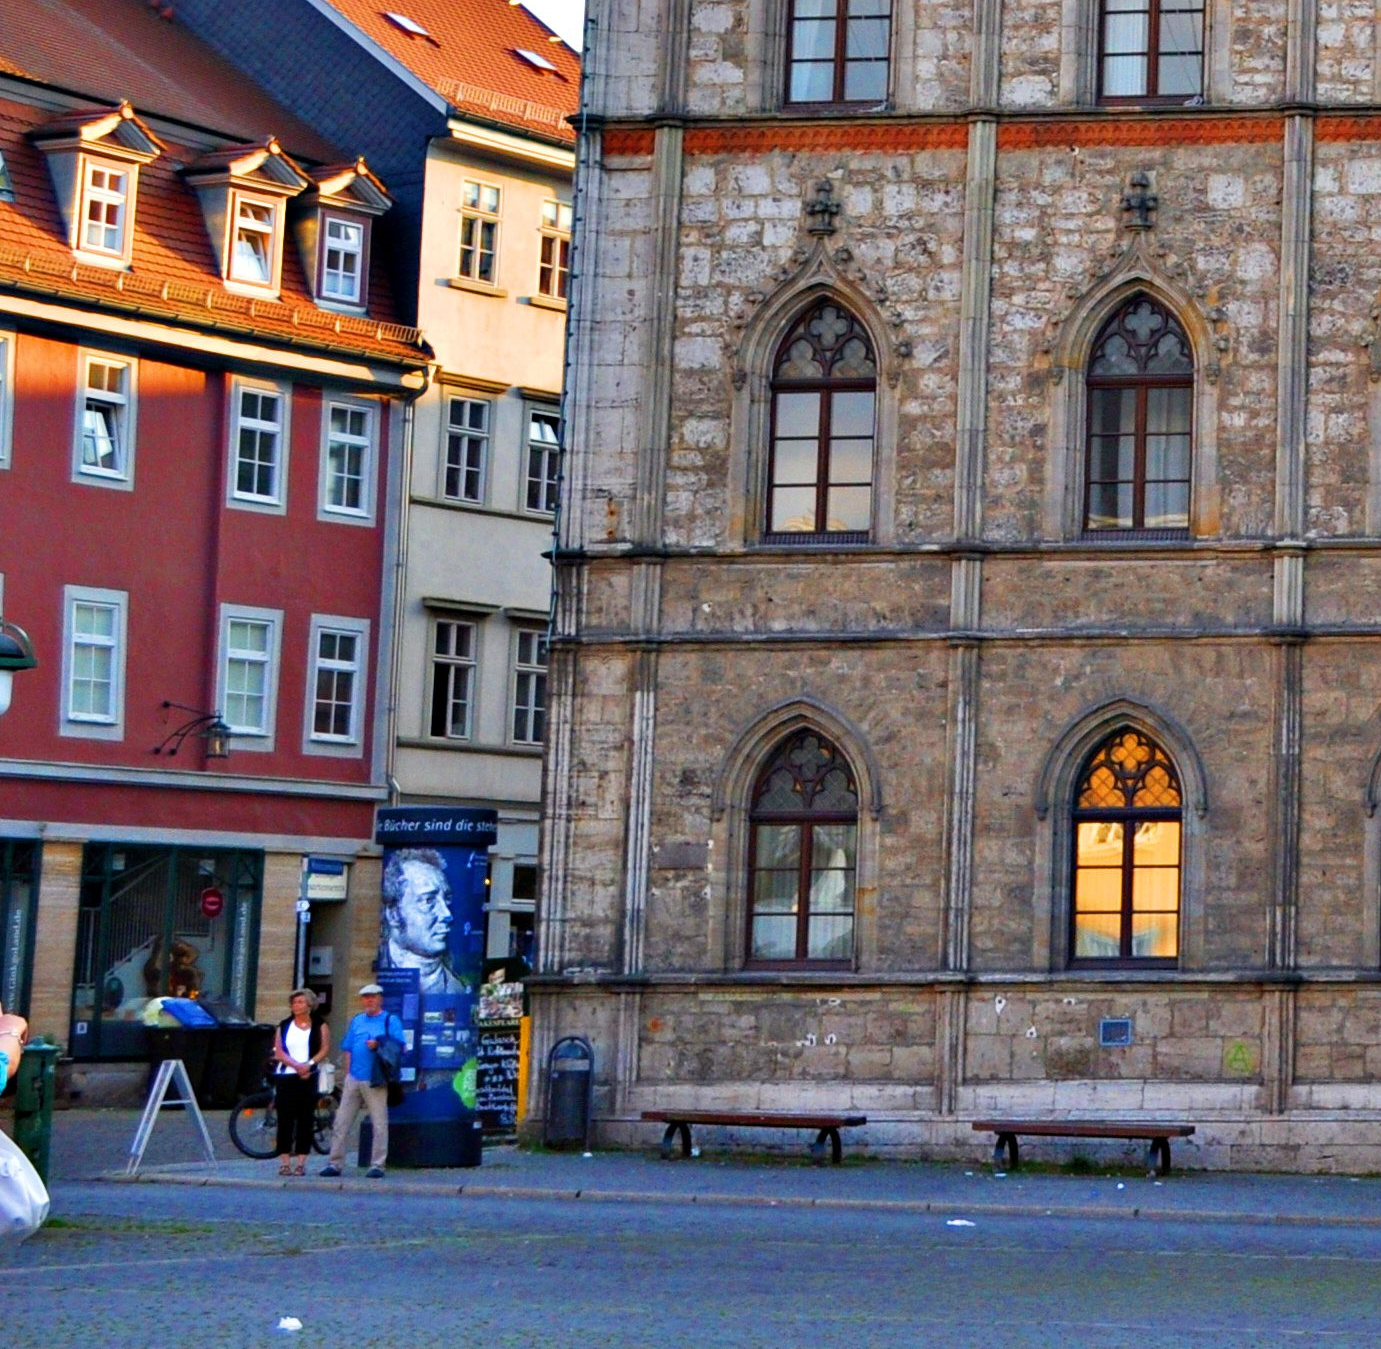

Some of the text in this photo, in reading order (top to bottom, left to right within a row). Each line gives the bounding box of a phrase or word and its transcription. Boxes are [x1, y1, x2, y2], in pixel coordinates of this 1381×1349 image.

[384, 818, 421, 833] Bücher
[423, 817, 453, 833] sind
[455, 817, 474, 833] die
